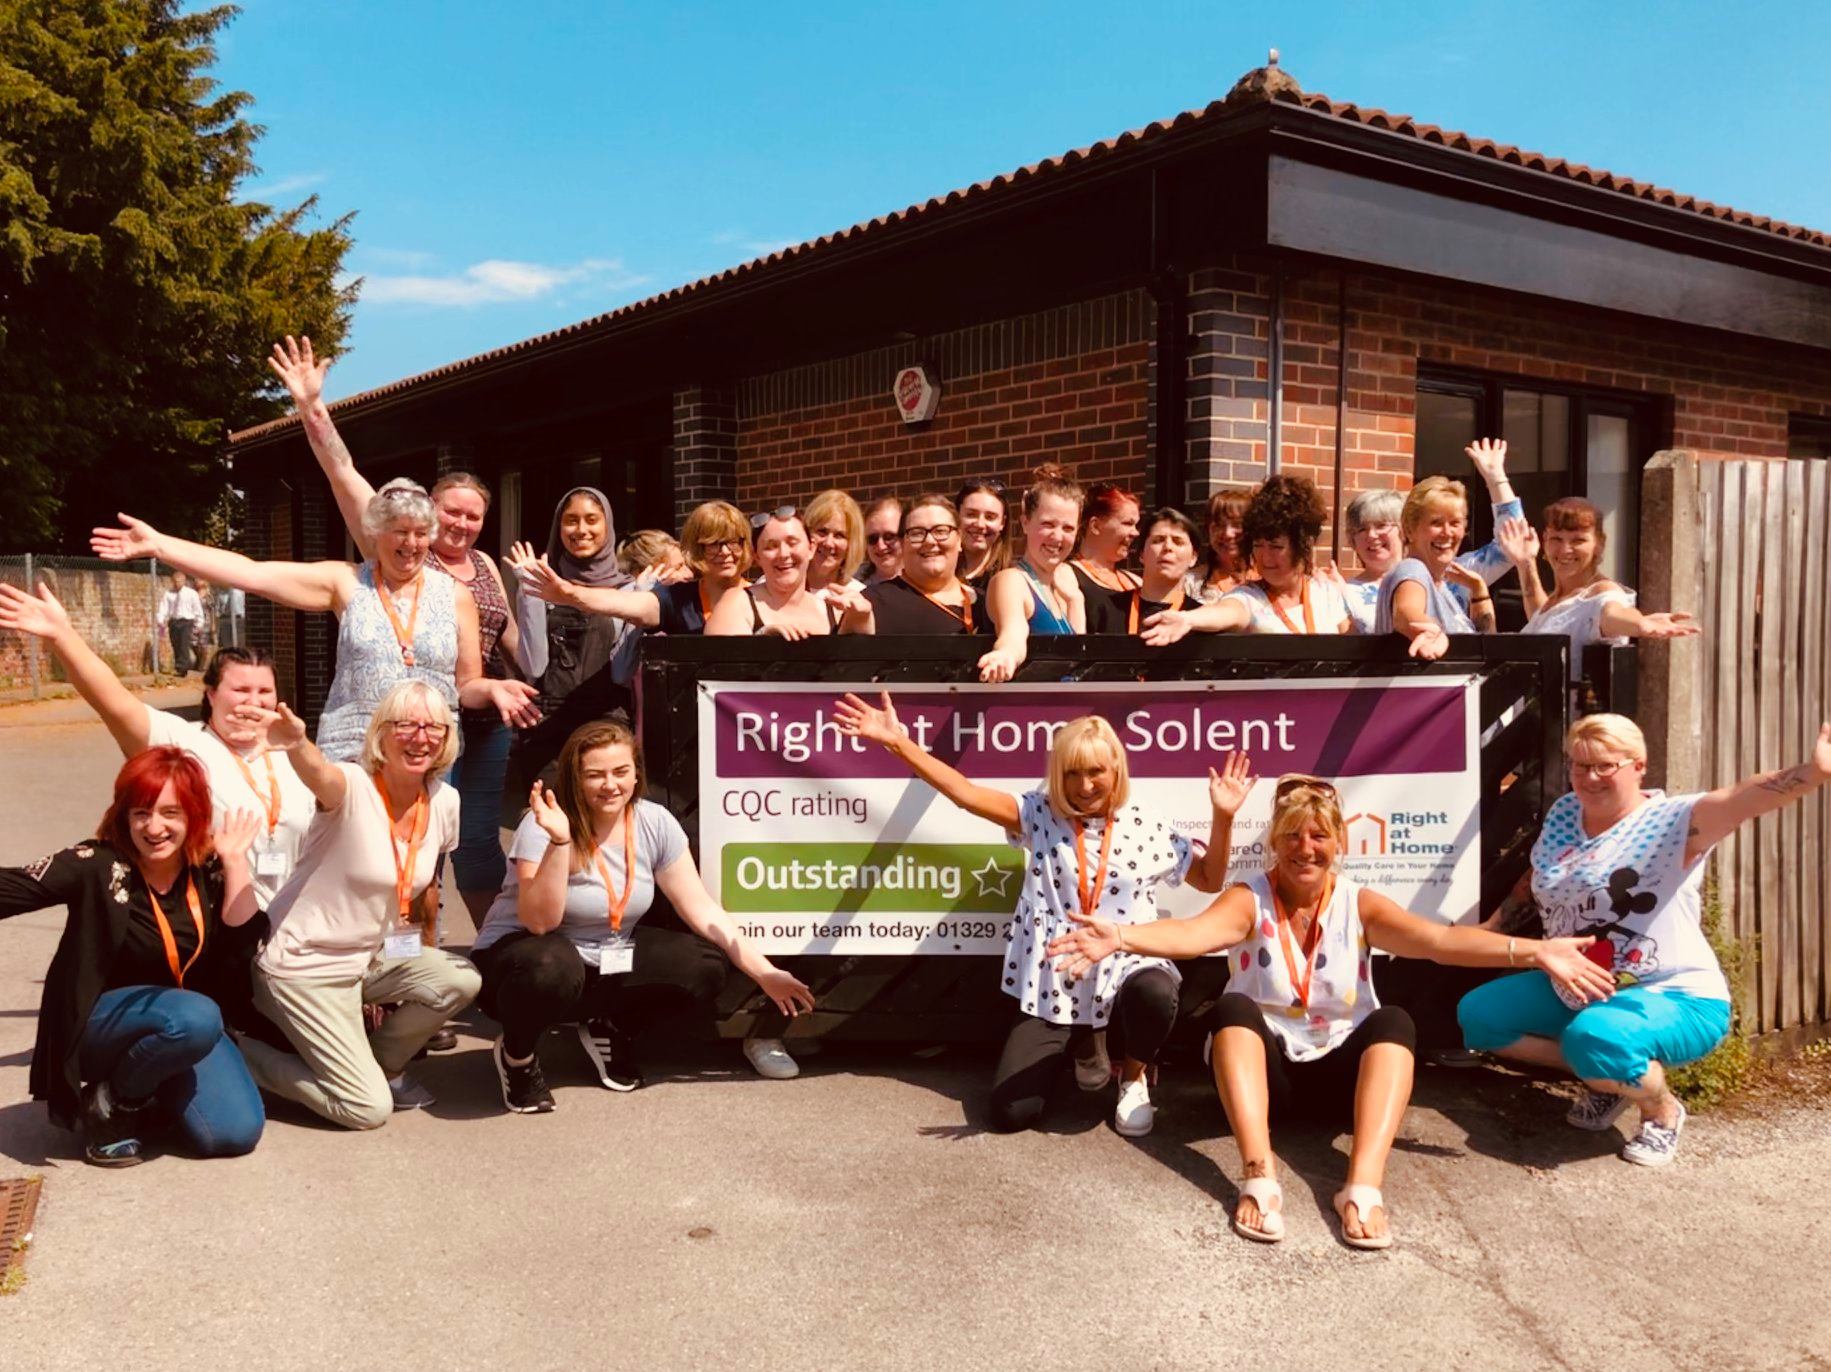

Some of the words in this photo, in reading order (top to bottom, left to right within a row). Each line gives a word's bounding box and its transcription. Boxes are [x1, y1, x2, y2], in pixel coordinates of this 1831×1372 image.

[883, 714, 934, 752] t
[952, 711, 1070, 752] Hom
[1126, 708, 1297, 752] Solent
[723, 790, 782, 822] CQC
[792, 790, 868, 823] rating
[1390, 812, 1448, 827] Right
[1390, 828, 1411, 839] at
[1390, 842, 1455, 854] Home
[1343, 862, 1372, 870] Quality
[1374, 862, 1393, 870] Care
[1396, 862, 1406, 870] in
[1408, 862, 1427, 870] Your
[736, 855, 962, 899] Outstanding
[772, 925, 806, 938] our
[811, 922, 862, 938] team
[869, 921, 930, 943] today:
[937, 921, 996, 938] 01329
